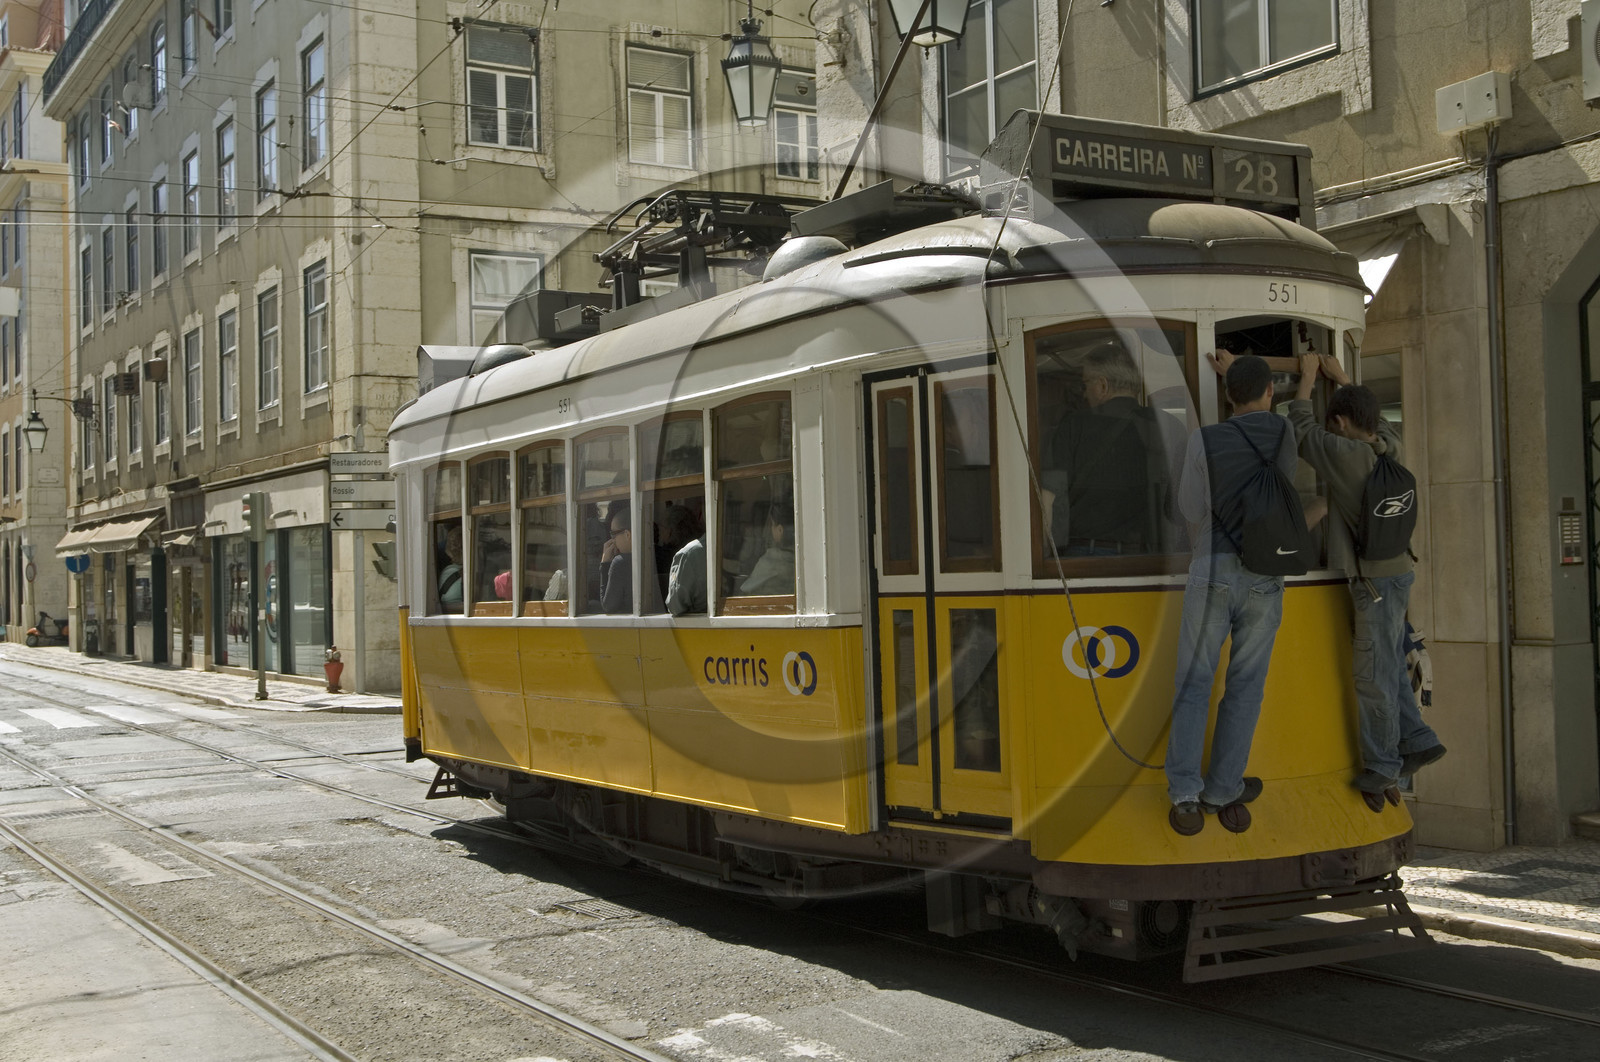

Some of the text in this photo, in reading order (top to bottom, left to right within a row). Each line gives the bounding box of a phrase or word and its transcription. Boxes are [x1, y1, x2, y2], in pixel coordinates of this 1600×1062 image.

[1055, 137, 1170, 177] CARREIRA
[1234, 158, 1279, 197] 28
[1268, 282, 1298, 305] 551
[558, 397, 571, 414] 551
[331, 458, 383, 467] Restauradores
[332, 486, 355, 495] Rossio
[703, 644, 769, 687] carris
